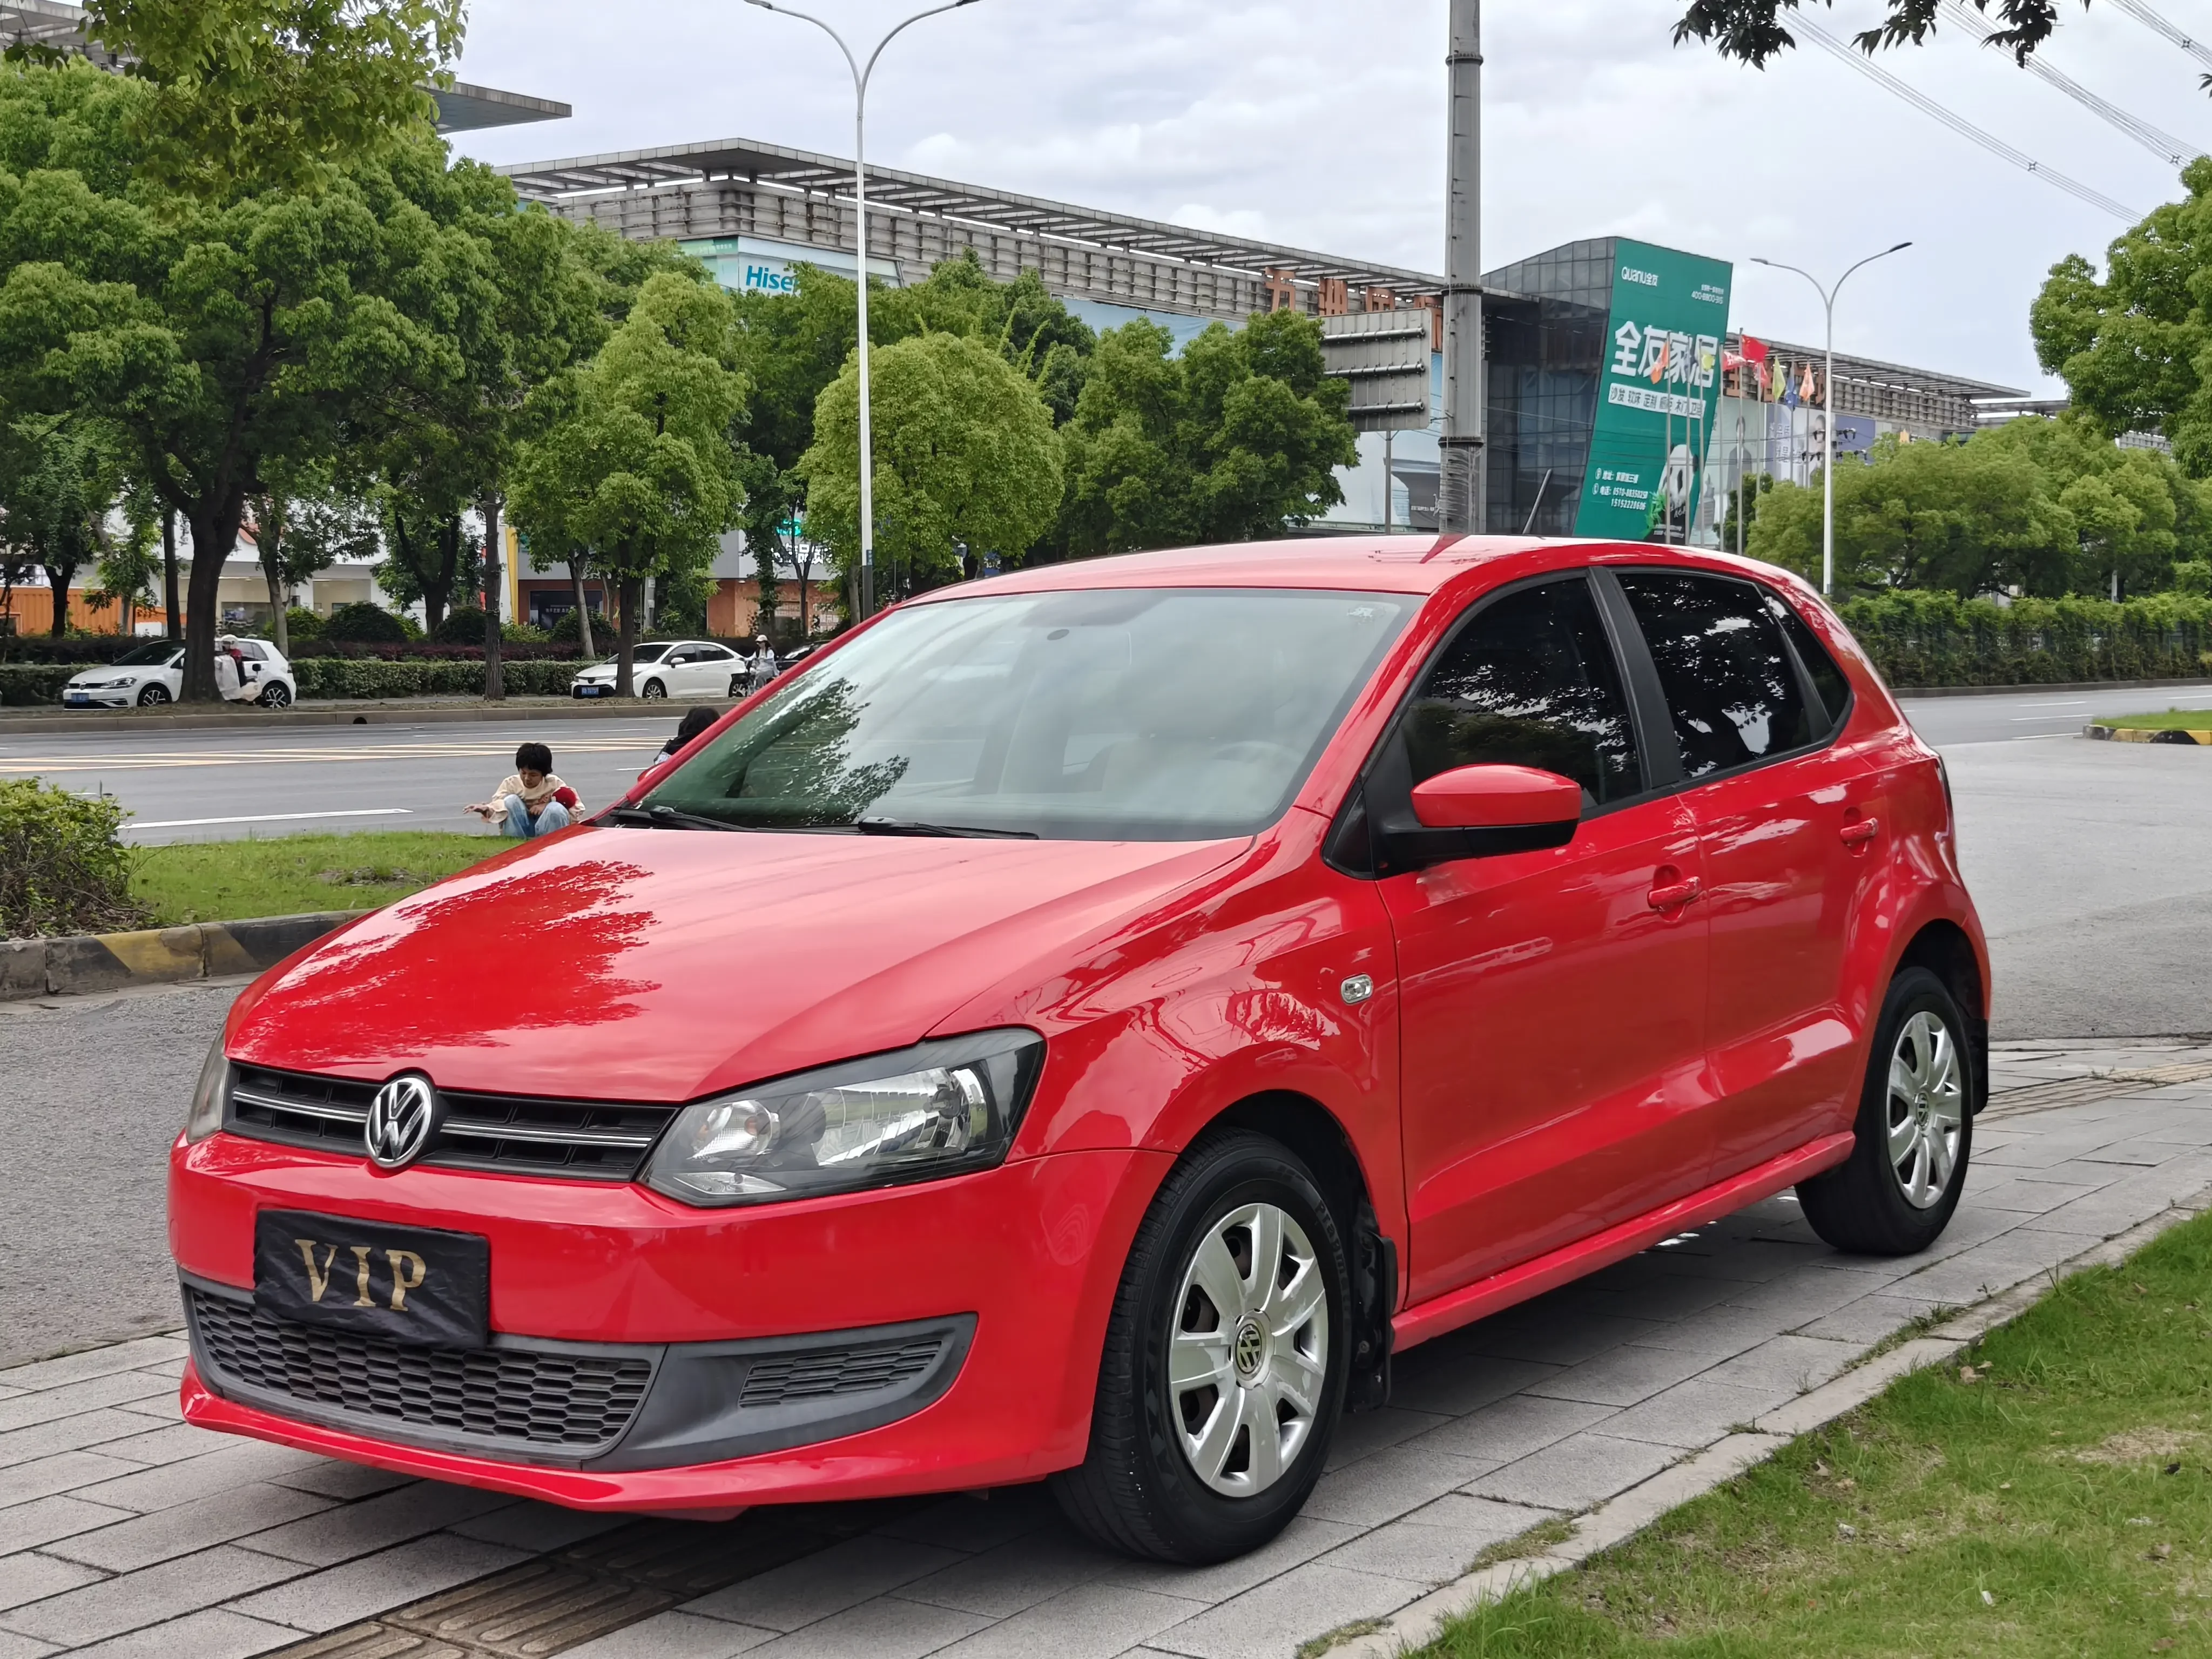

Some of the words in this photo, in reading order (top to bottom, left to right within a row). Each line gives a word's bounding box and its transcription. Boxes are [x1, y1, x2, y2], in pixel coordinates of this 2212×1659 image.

[1611, 320, 1718, 388] 全友家居
[295, 1238, 427, 1312] VIP
